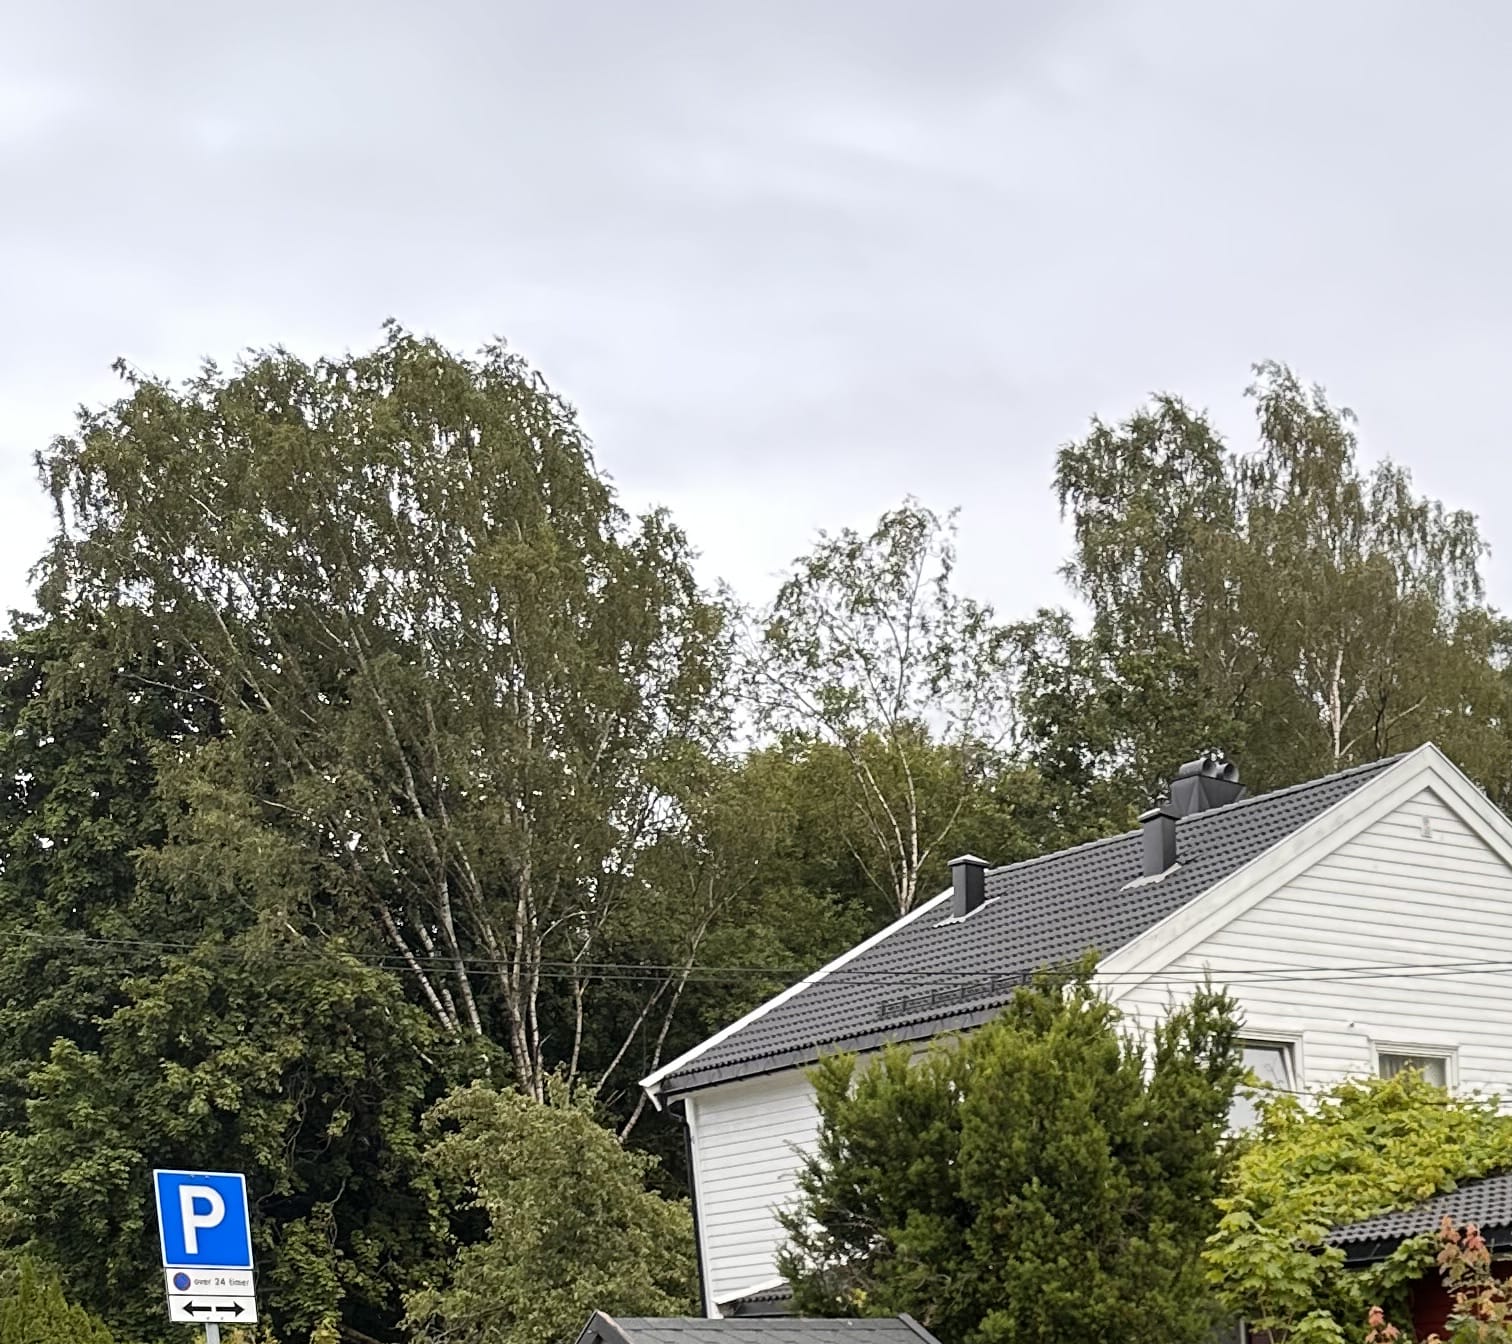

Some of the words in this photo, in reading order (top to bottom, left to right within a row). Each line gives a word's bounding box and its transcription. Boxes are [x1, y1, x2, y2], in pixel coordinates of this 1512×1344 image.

[178, 1184, 226, 1255] P
[193, 1278, 212, 1287] over
[214, 1277, 226, 1287] 24
[228, 1277, 250, 1288] timer
